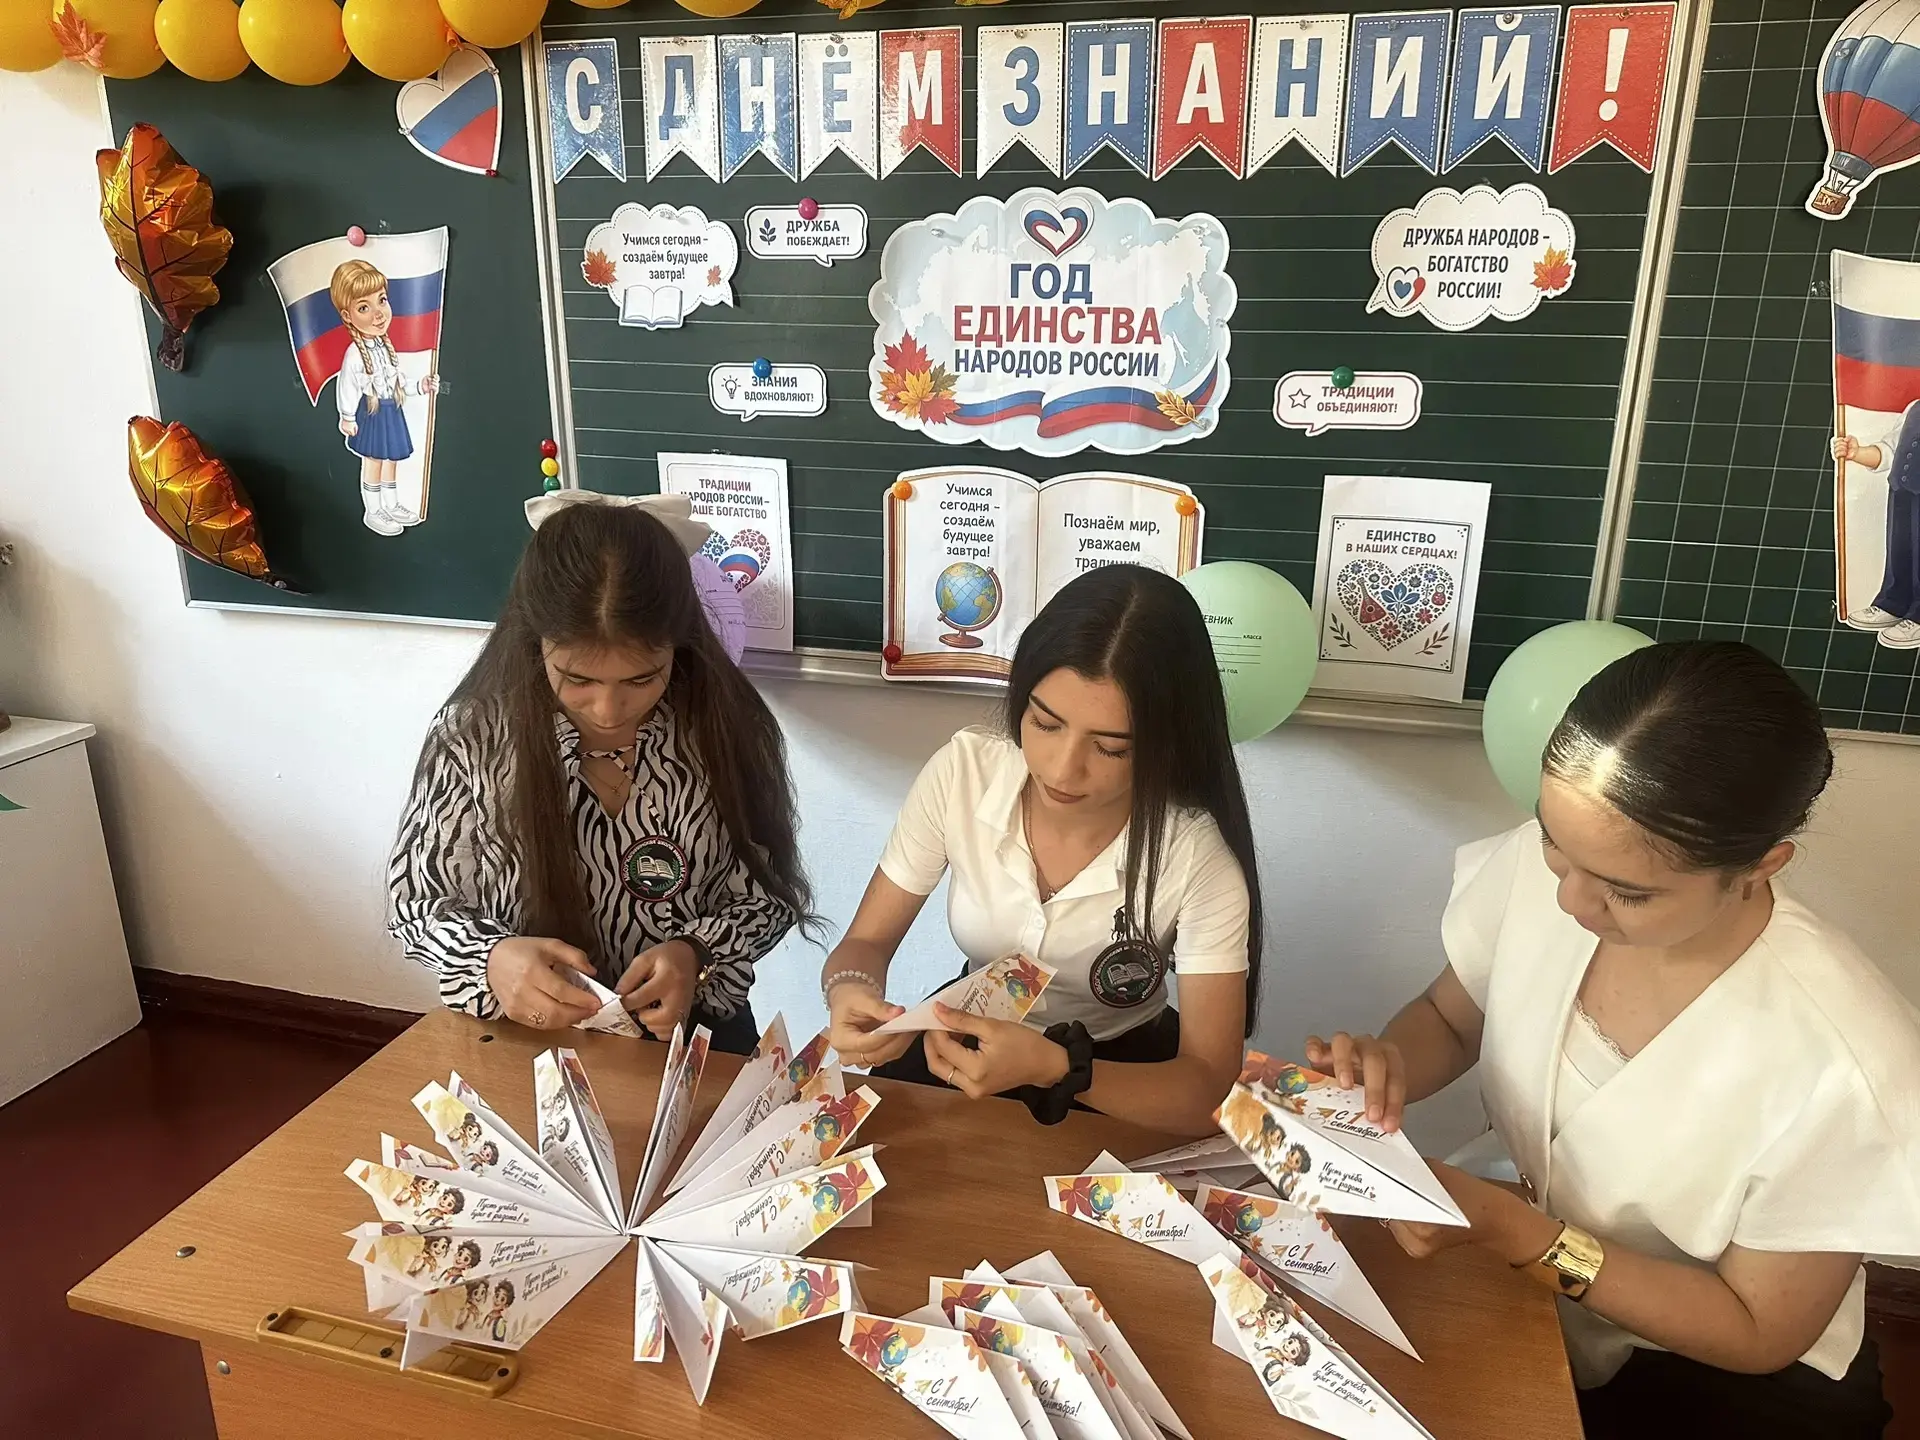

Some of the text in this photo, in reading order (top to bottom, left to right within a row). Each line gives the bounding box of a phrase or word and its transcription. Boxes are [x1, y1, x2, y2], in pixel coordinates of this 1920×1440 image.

[565, 57, 600, 135] С
[659, 44, 943, 141] ДНЁМ
[786, 220, 840, 233] ДРУЖБА
[622, 233, 660, 246] Учимся
[662, 235, 702, 249] сегодня
[786, 236, 850, 247] ПОБЕЖДАЕТ!
[1403, 228, 1464, 247] ДРУЖБА
[1468, 229, 1539, 247] НАРОДОВ
[622, 251, 708, 265] создаём будущее
[1427, 255, 1509, 273] БОГАТСТВО
[649, 268, 685, 281] завтра!
[1010, 263, 1093, 304] ГОД
[1437, 282, 1502, 299] РОССИИ!
[954, 305, 1162, 348] ЕДИНСТВА
[954, 349, 1159, 378] НАРОДОВ РОССИИ
[751, 376, 798, 388] ЗНАНИЯ
[744, 391, 814, 403] ВДОХНОВЛЯЮТ!
[1321, 386, 1395, 400] ТРАДИЦИИ
[1317, 402, 1398, 414] ОБЪЕДИНЯЮТ!
[699, 479, 751, 492] ТРАДИЦИИ
[946, 483, 993, 497] Учимся
[681, 491, 725, 503] АРОДОВ
[728, 494, 763, 506] РОССИИ
[692, 505, 767, 519] АШЕ БОГАТСТВО
[940, 500, 990, 513] сегодня
[943, 516, 995, 528] создаём
[1064, 513, 1160, 535] Познаём мир,
[943, 529, 994, 544] будущее
[1366, 529, 1436, 544] ЕДИНСТВО
[1079, 538, 1141, 552] уважаем
[1346, 543, 1458, 560] В НАШИХ СЕРДЦАХ!
[946, 546, 990, 559] завтра!
[1202, 614, 1233, 625] ЕВНИК
[1145, 1224, 1189, 1241] сентября!
[1285, 1259, 1336, 1276] сентября!
[926, 1397, 979, 1415] сентября!
